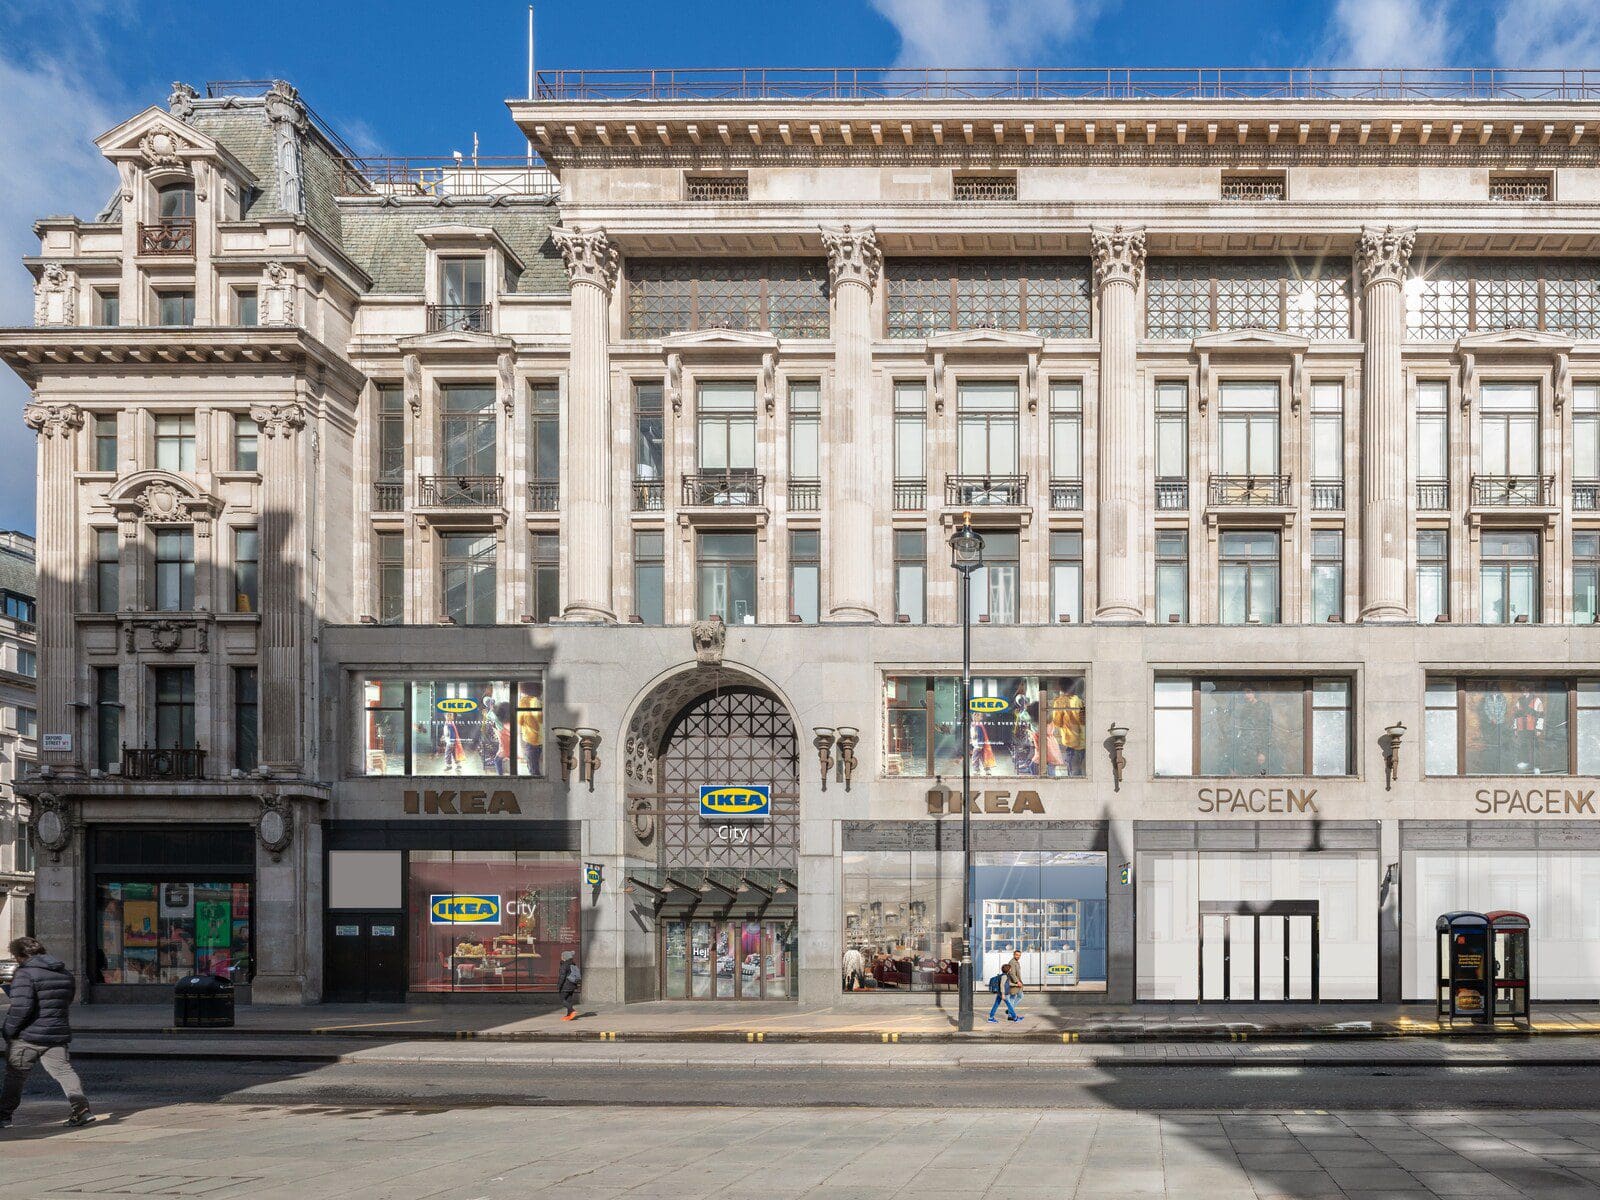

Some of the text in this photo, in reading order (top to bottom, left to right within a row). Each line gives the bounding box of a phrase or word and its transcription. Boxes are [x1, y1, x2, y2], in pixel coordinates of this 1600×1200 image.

[971, 701, 1004, 709] IKEA
[403, 790, 522, 815] IKEA
[707, 794, 764, 806] IKEA
[927, 790, 1046, 814] IKEA
[718, 825, 749, 843] City
[438, 901, 536, 919] IKEA City
